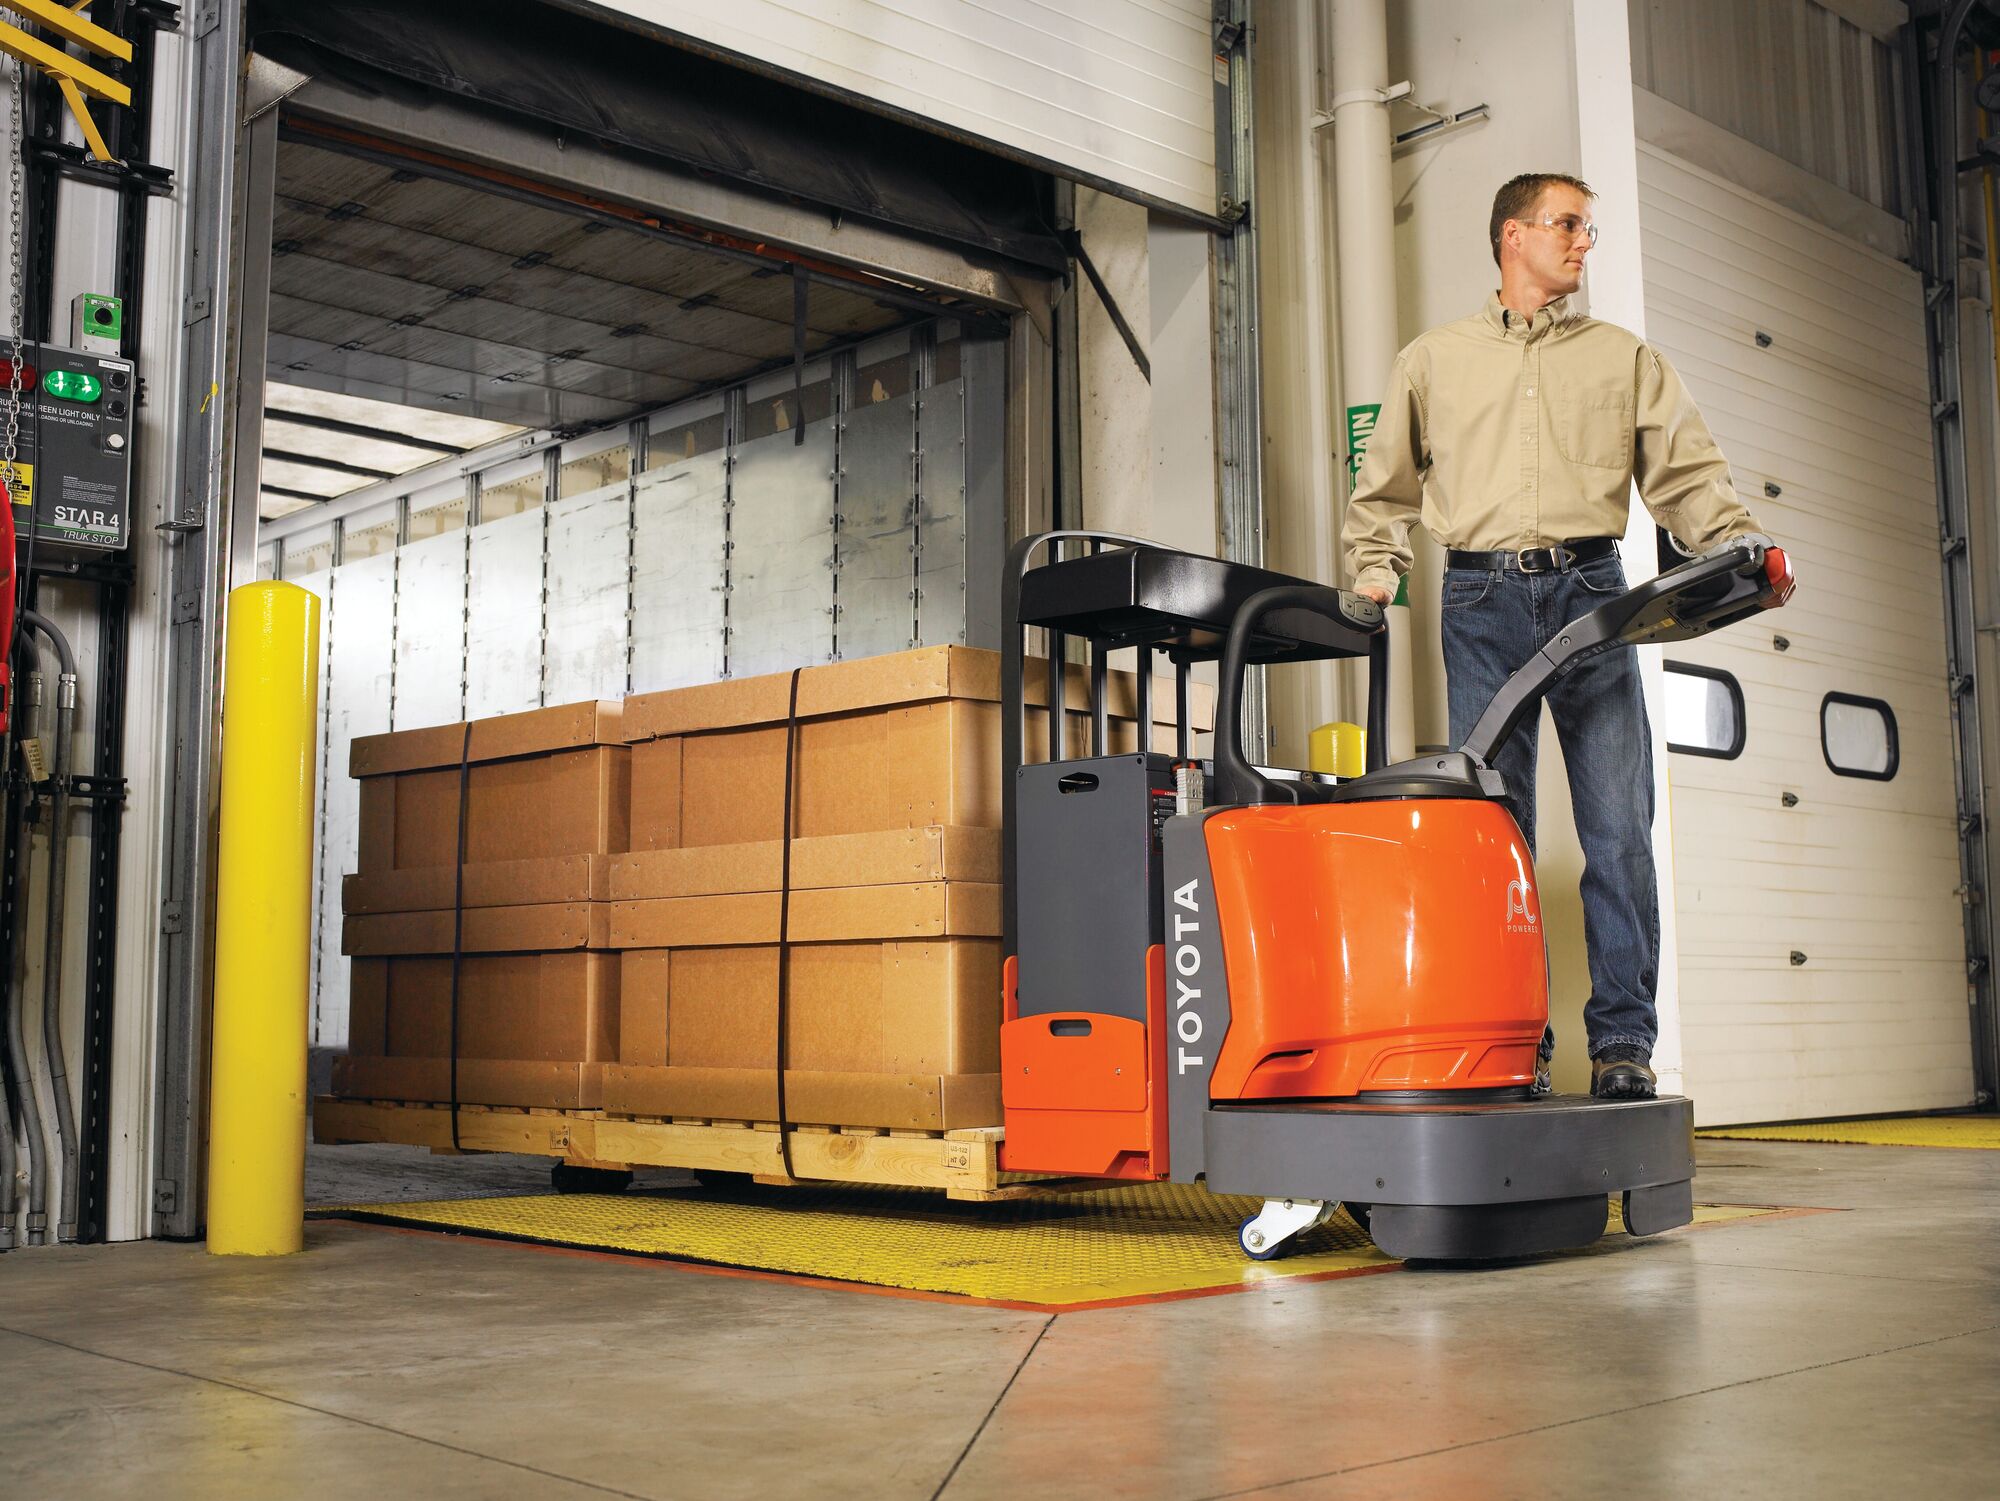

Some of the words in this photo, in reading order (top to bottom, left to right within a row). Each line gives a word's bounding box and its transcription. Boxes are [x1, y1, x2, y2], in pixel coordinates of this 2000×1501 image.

[58, 408, 80, 418] LIGHT
[81, 411, 101, 421] ONLY
[67, 418, 94, 428] UNLOADING
[1352, 411, 1375, 486] RAIN
[54, 505, 105, 526] STAR
[109, 513, 120, 528] 4
[63, 530, 90, 541] TRUK
[91, 533, 119, 545] STOP
[1174, 878, 1204, 1075] TOYOTA
